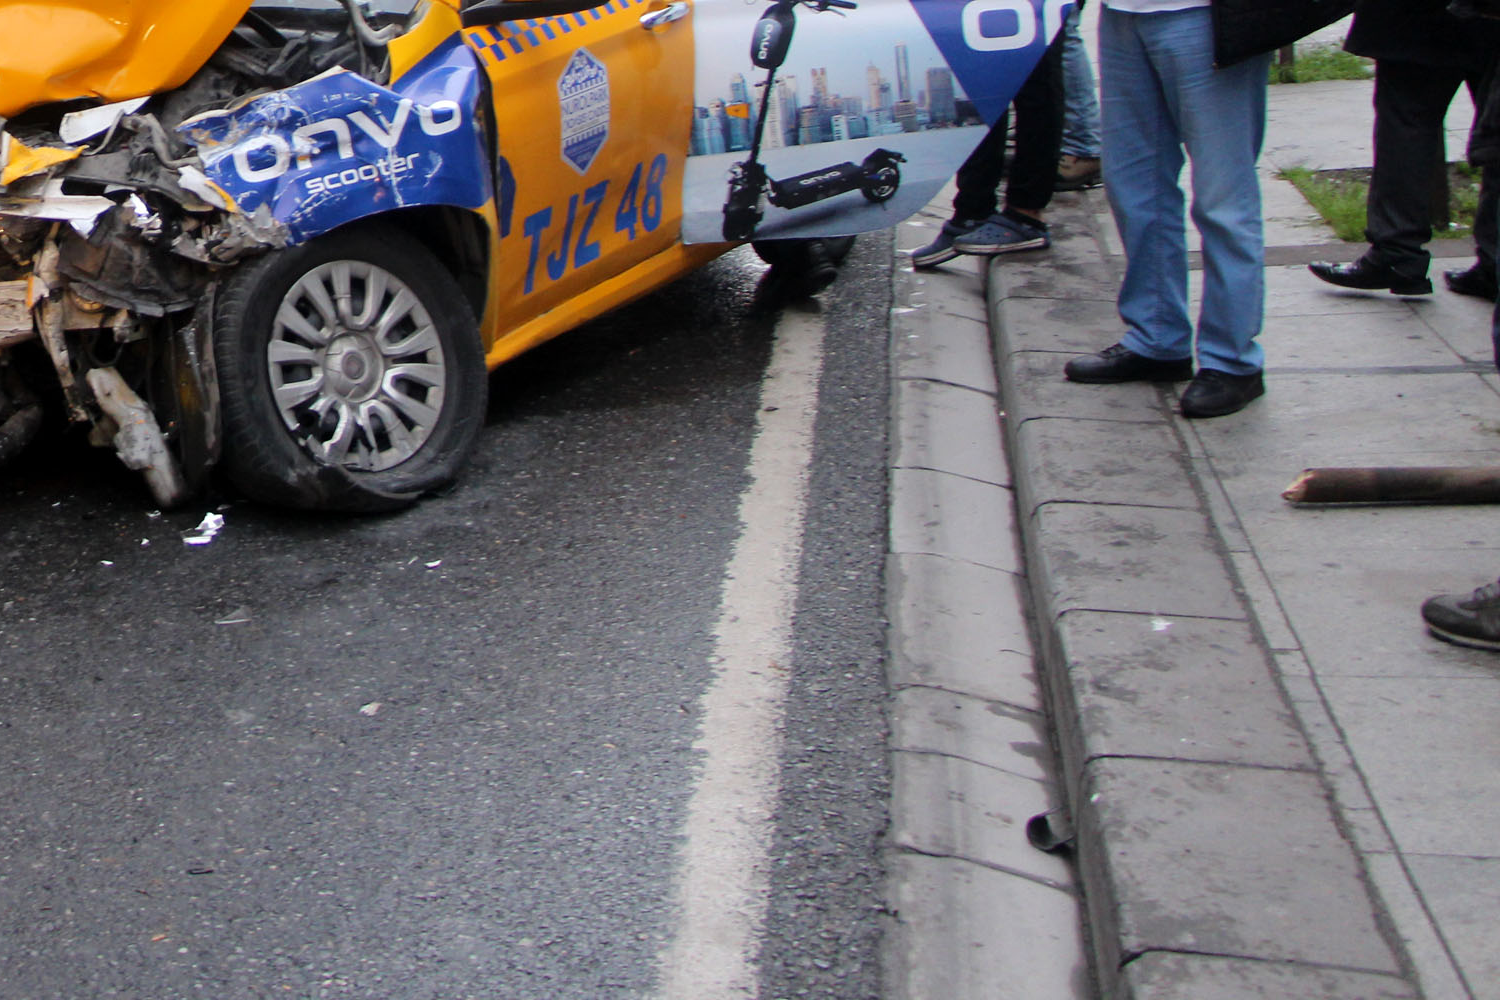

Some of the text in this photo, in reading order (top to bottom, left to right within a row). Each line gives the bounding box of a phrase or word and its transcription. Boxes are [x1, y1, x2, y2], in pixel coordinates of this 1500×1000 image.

[233, 98, 462, 183] onvo
[304, 152, 421, 195] scooter
[523, 152, 668, 296] TJZ 48
